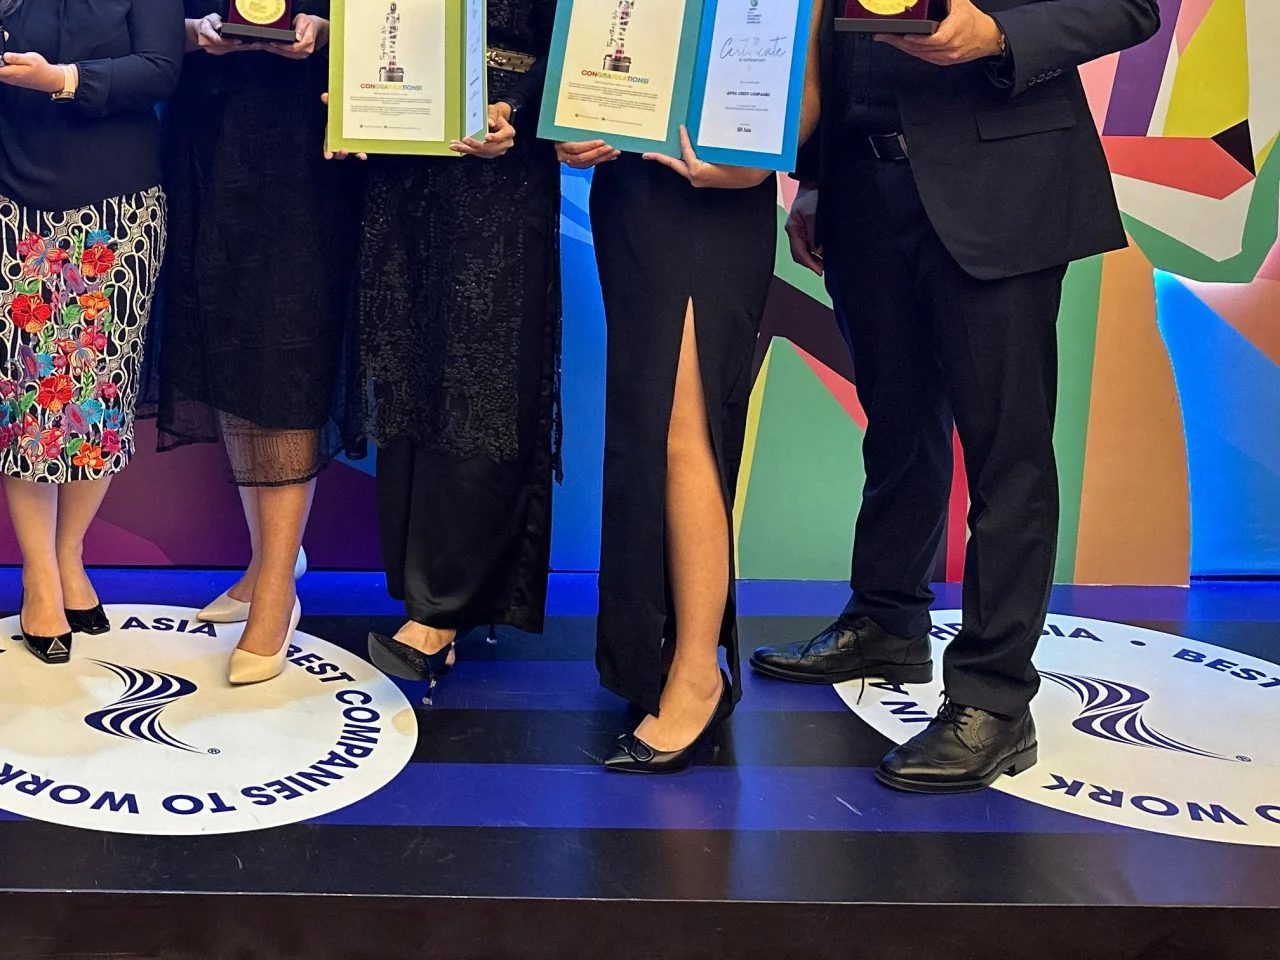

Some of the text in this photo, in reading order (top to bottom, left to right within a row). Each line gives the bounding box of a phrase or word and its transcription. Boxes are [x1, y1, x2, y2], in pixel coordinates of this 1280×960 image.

[360, 83, 423, 91] CONGRATIONS!
[120, 616, 218, 637] ASIA
[1041, 624, 1104, 642] IA
[286, 644, 356, 683] BEST
[240, 689, 382, 806] COMPANIES
[162, 792, 237, 815] TO
[1040, 773, 1249, 826] WORK
